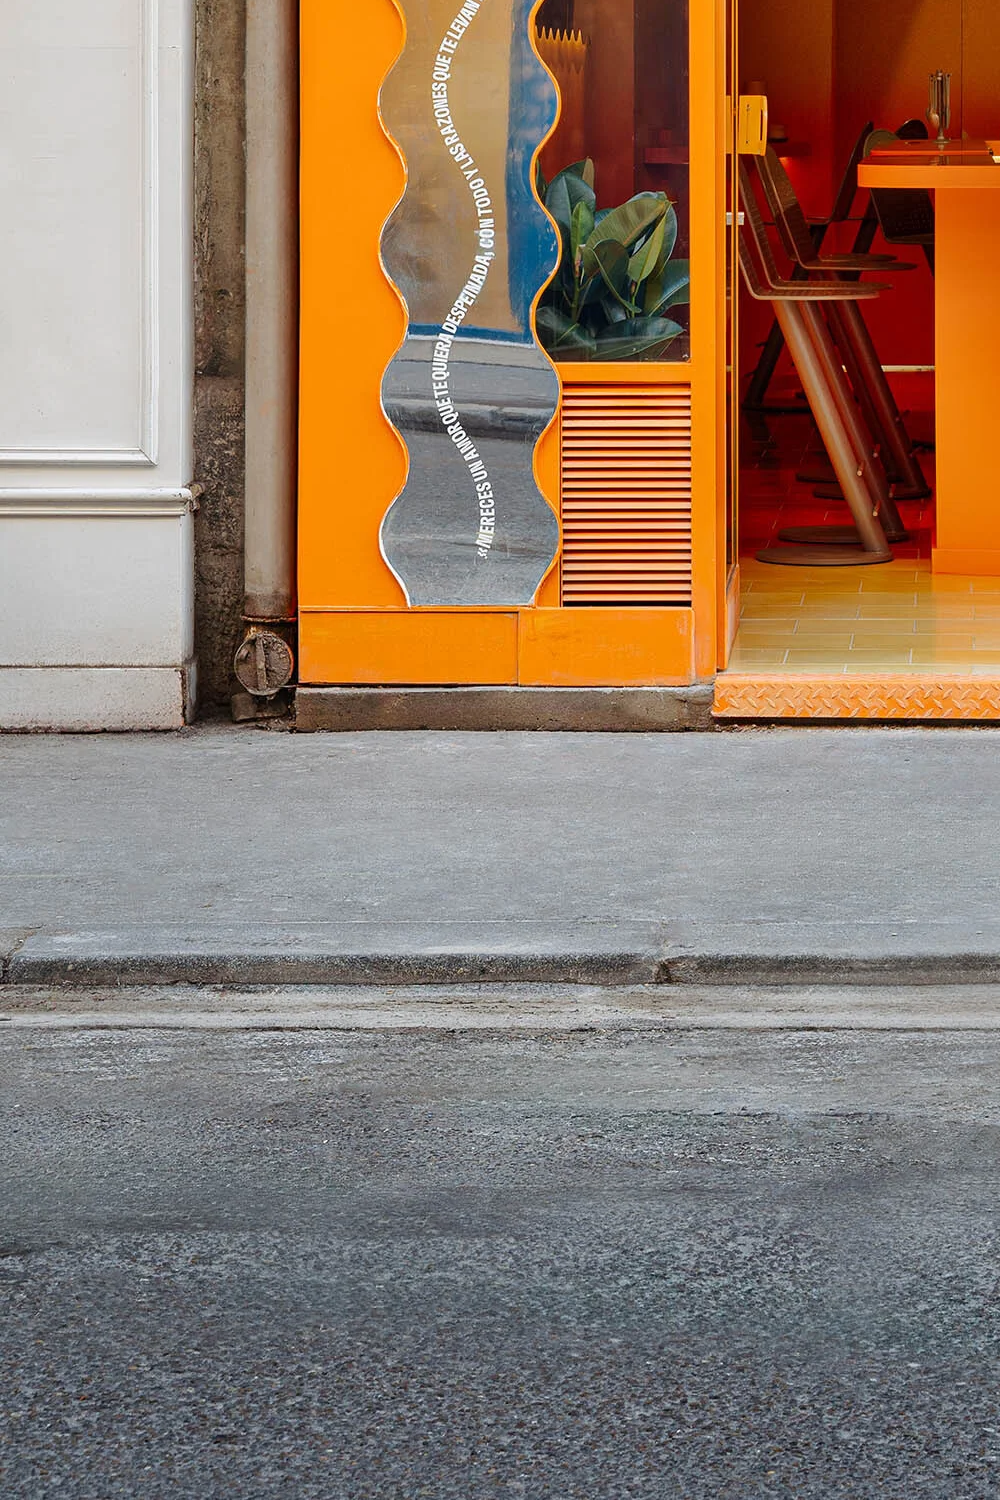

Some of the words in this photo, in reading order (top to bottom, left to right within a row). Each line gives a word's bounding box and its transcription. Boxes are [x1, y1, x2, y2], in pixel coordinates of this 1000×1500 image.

[439, 36, 458, 55] TE
[432, 53, 452, 82] QUE
[432, 82, 460, 147] RAZONES
[449, 142, 474, 170] LAS
[462, 168, 479, 181] Y
[468, 177, 493, 217] TODO
[479, 217, 495, 248] CON
[442, 252, 495, 334] DESPEINADA,
[432, 333, 454, 381] QUIERA
[433, 381, 449, 399] TE
[436, 397, 459, 425] QUE
[447, 423, 480, 461] AMOR
[468, 460, 488, 482] UN
